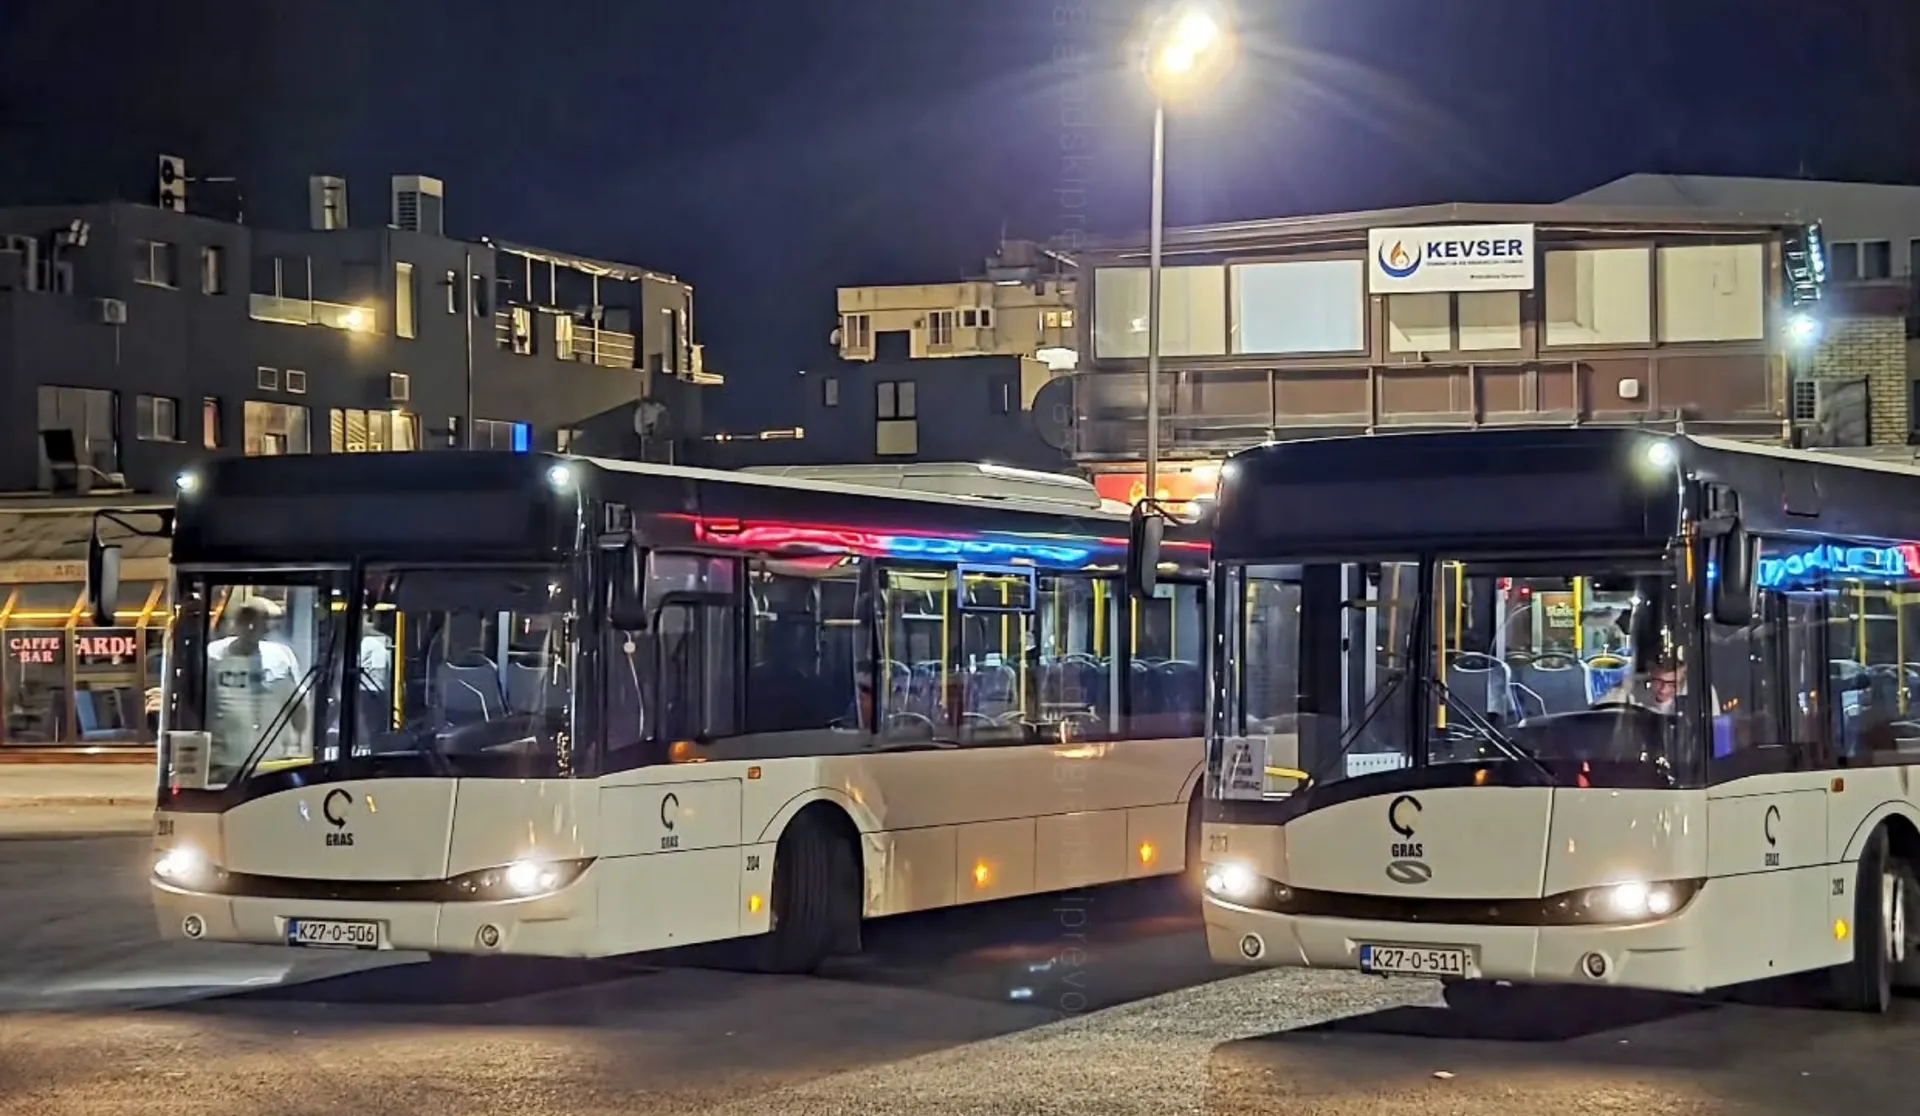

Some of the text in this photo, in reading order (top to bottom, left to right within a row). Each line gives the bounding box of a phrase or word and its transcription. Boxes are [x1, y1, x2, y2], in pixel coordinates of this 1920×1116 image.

[1427, 239, 1523, 258] KEVSER
[10, 637, 60, 650] CAFFE
[20, 651, 53, 663] BAR
[326, 833, 354, 846] GRAS
[1391, 843, 1423, 857] GRAS
[746, 855, 760, 871] 204
